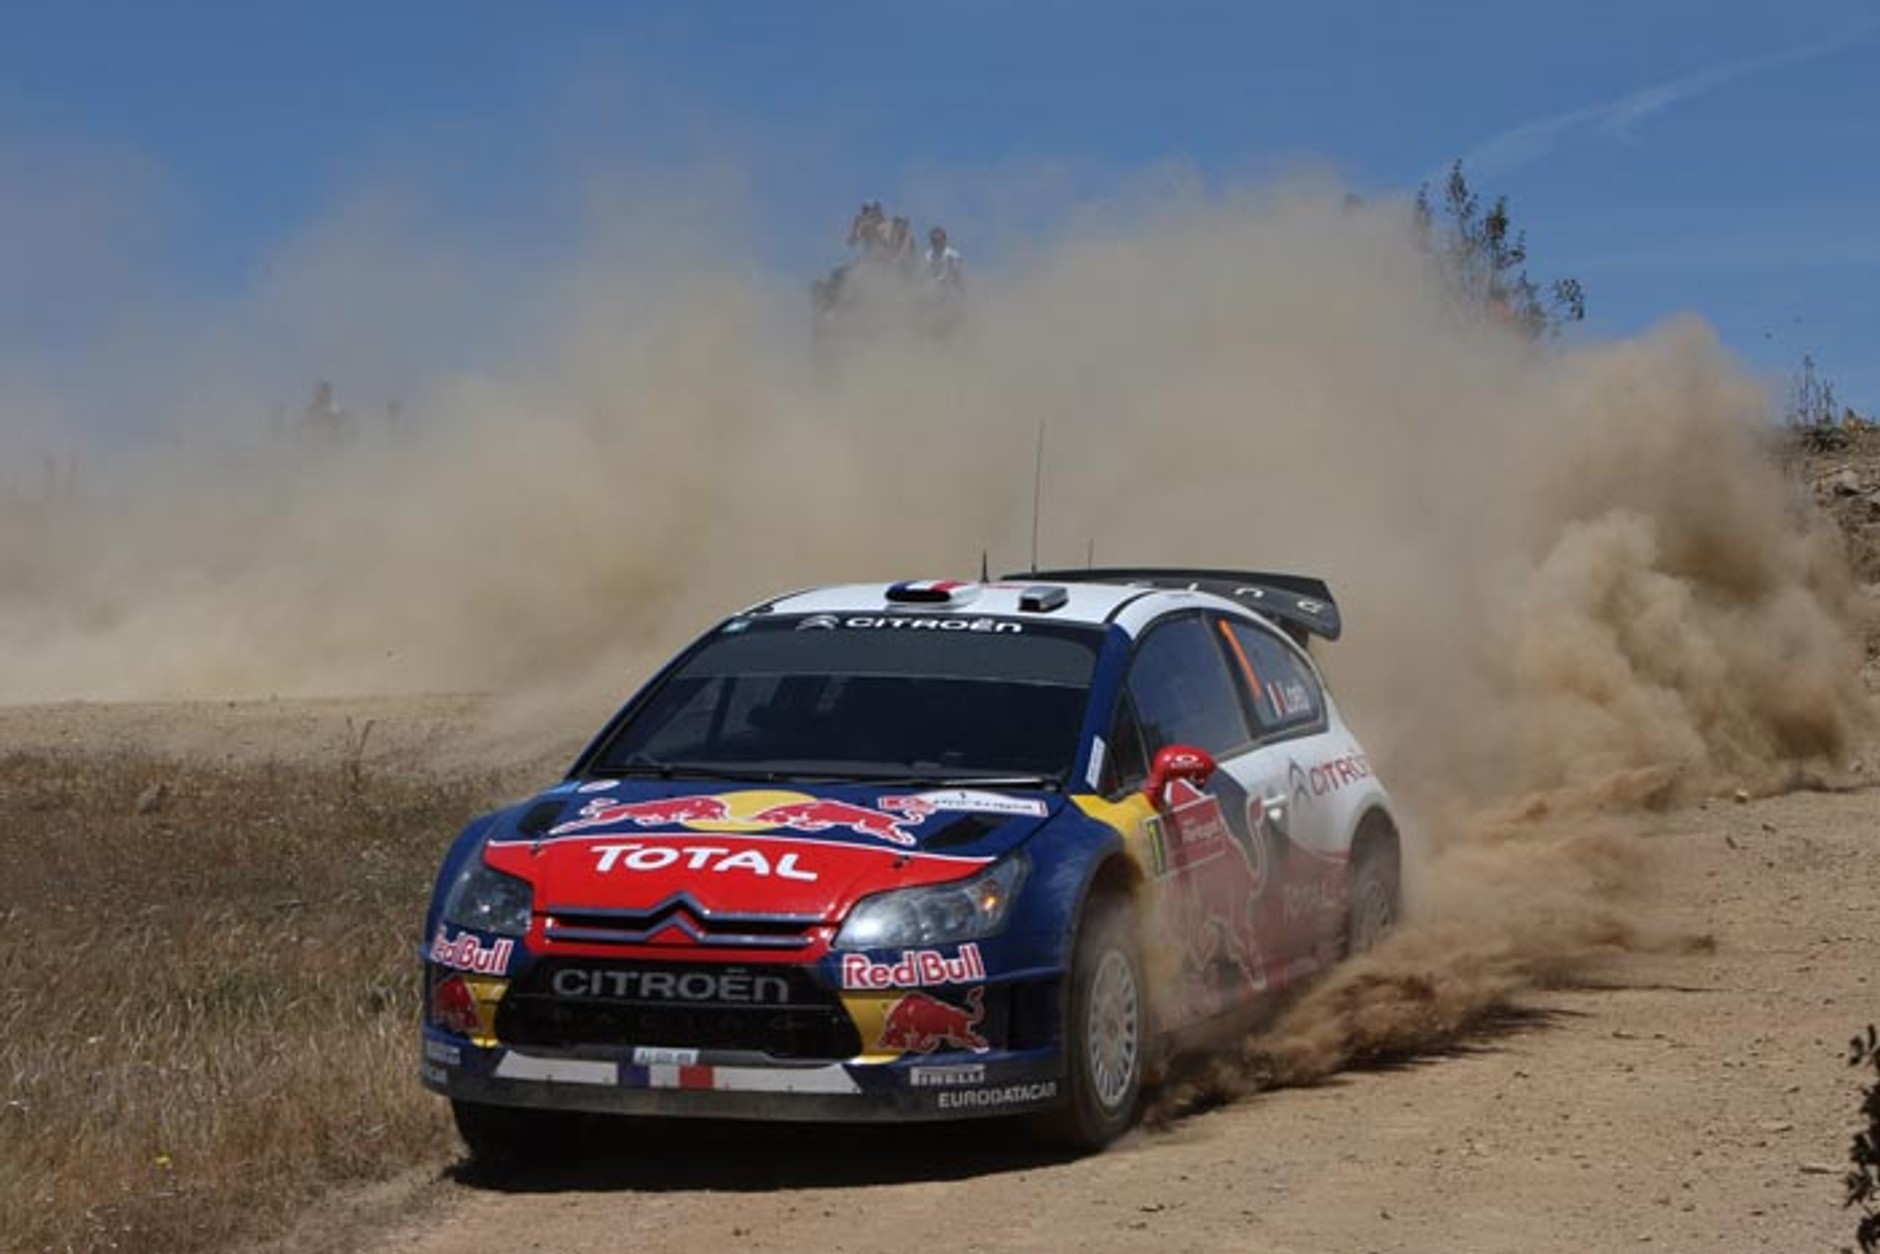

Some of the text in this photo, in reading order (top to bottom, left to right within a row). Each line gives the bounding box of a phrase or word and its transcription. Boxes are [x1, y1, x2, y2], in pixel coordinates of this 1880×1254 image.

[590, 844, 818, 881] TOTAL
[457, 932, 514, 976] Bull
[843, 942, 987, 989] Red Bull
[910, 1063, 986, 1086] PIRELLI
[937, 1081, 1058, 1109] EURODATACAR
